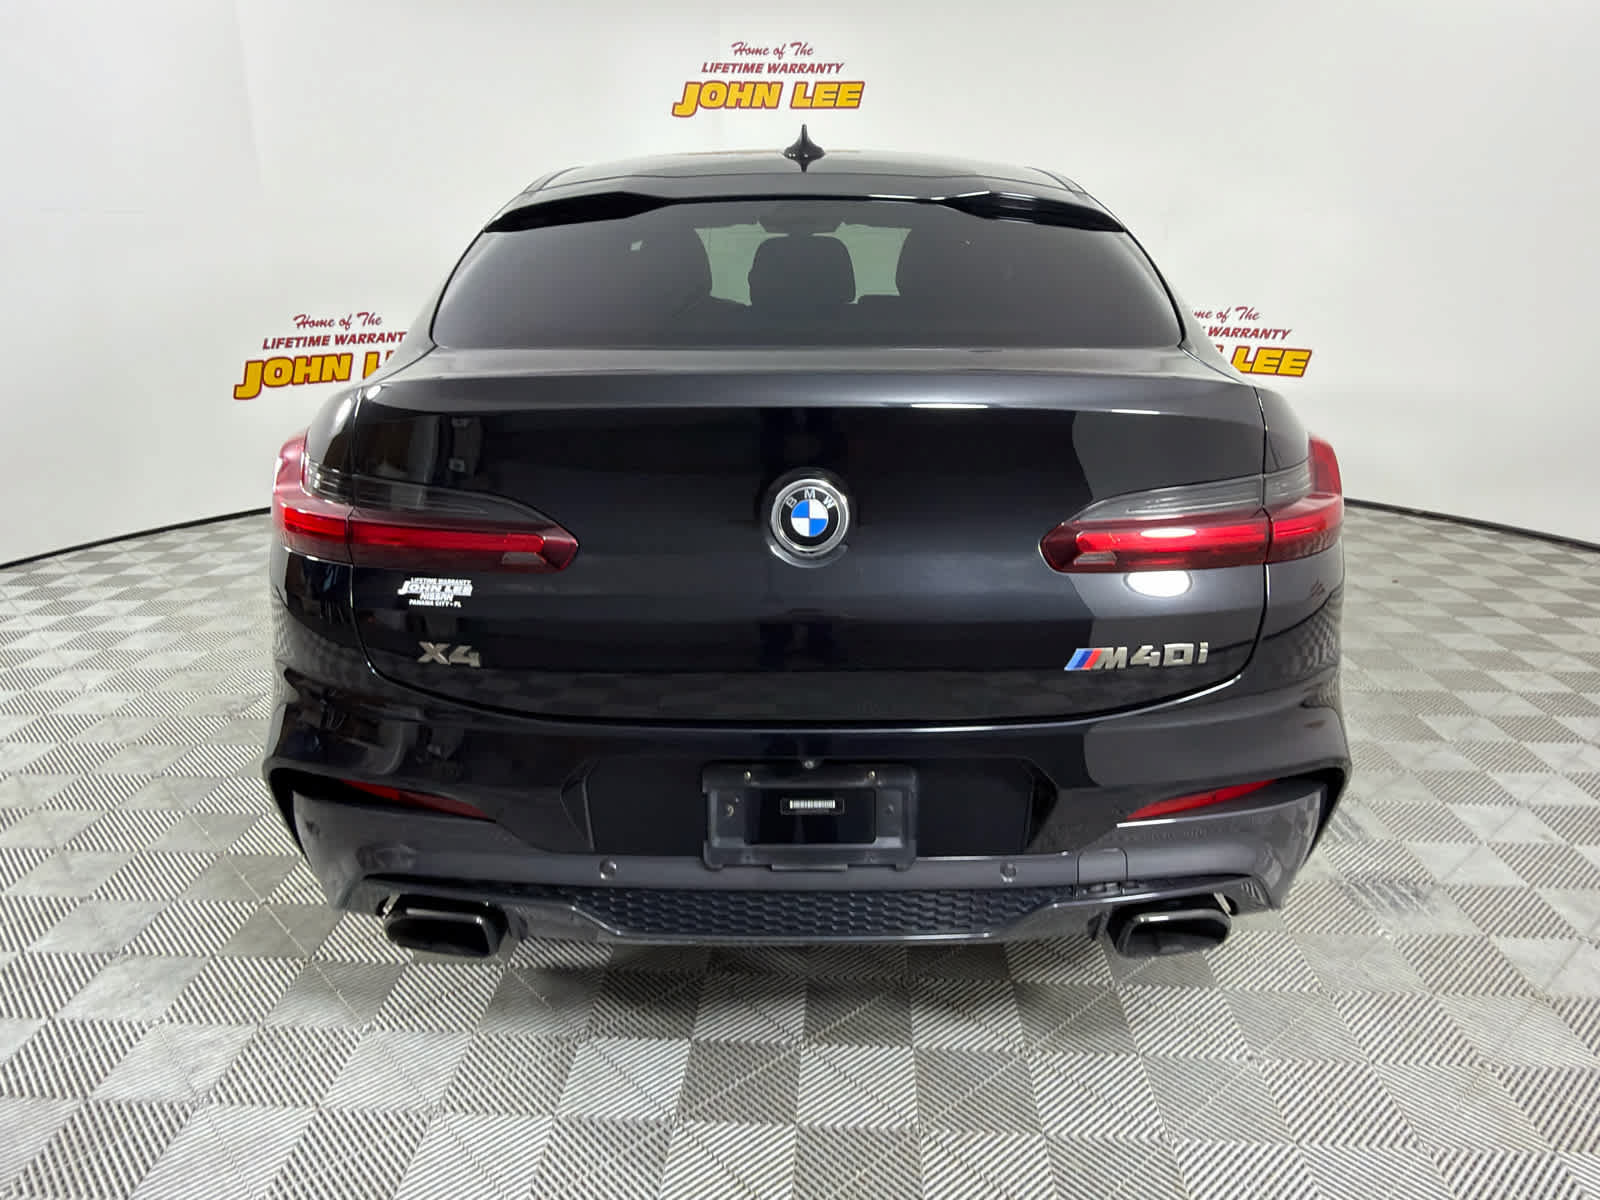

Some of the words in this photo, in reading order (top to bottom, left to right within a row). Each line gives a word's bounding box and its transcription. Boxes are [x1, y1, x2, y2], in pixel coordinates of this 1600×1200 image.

[731, 41, 769, 56] Home
[773, 43, 786, 60] of
[790, 42, 814, 56] The
[701, 62, 764, 73] LIFETIME
[767, 62, 845, 74] WARRANTY
[672, 80, 783, 118] JOHN
[790, 81, 865, 109] LEE
[293, 313, 334, 329] Home
[339, 313, 352, 330] of
[356, 312, 382, 326] The
[1216, 306, 1231, 323] of
[1235, 306, 1260, 321] The
[263, 335, 330, 350] LIFETIME
[334, 331, 407, 346] WARRANT
[1208, 325, 1292, 340] WARRANTY
[1231, 345, 1312, 377] LEE
[233, 353, 354, 400] JOHN
[785, 487, 837, 510] BMW
[397, 580, 443, 595] JOHN
[443, 583, 473, 597] LEE
[420, 592, 454, 601] NISSAN
[417, 641, 481, 667] X4
[1090, 641, 1209, 670] M40i
